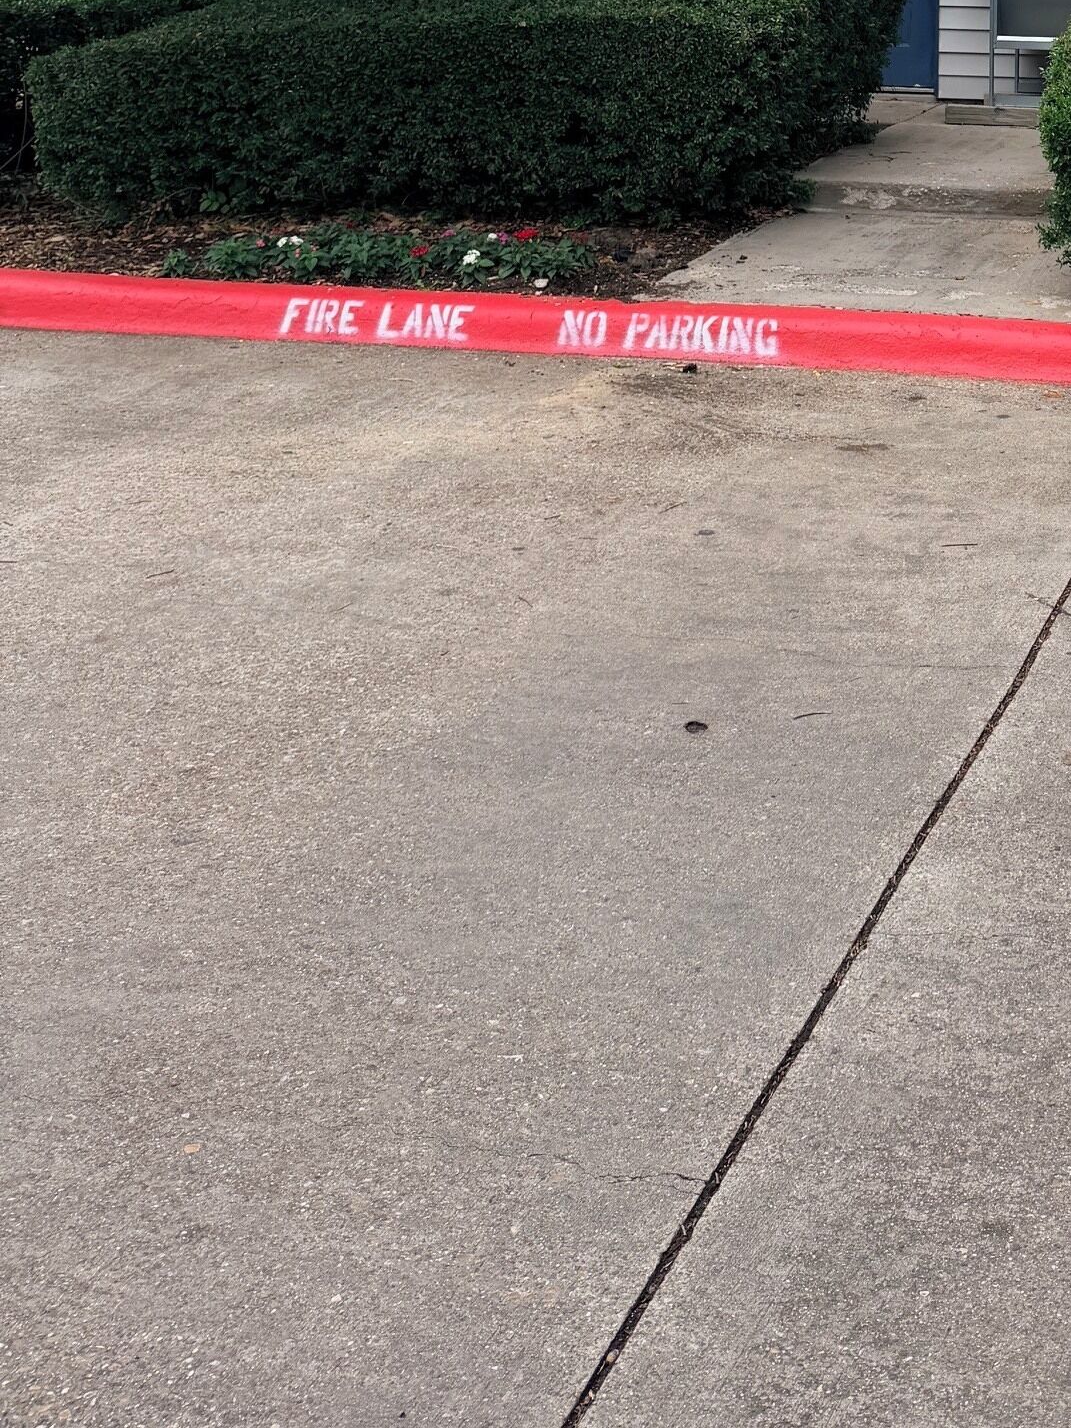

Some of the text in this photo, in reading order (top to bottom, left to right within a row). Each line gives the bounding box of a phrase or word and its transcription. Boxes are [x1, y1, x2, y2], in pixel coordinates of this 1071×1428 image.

[278, 297, 780, 357] FIRE LANE NO PARKING
